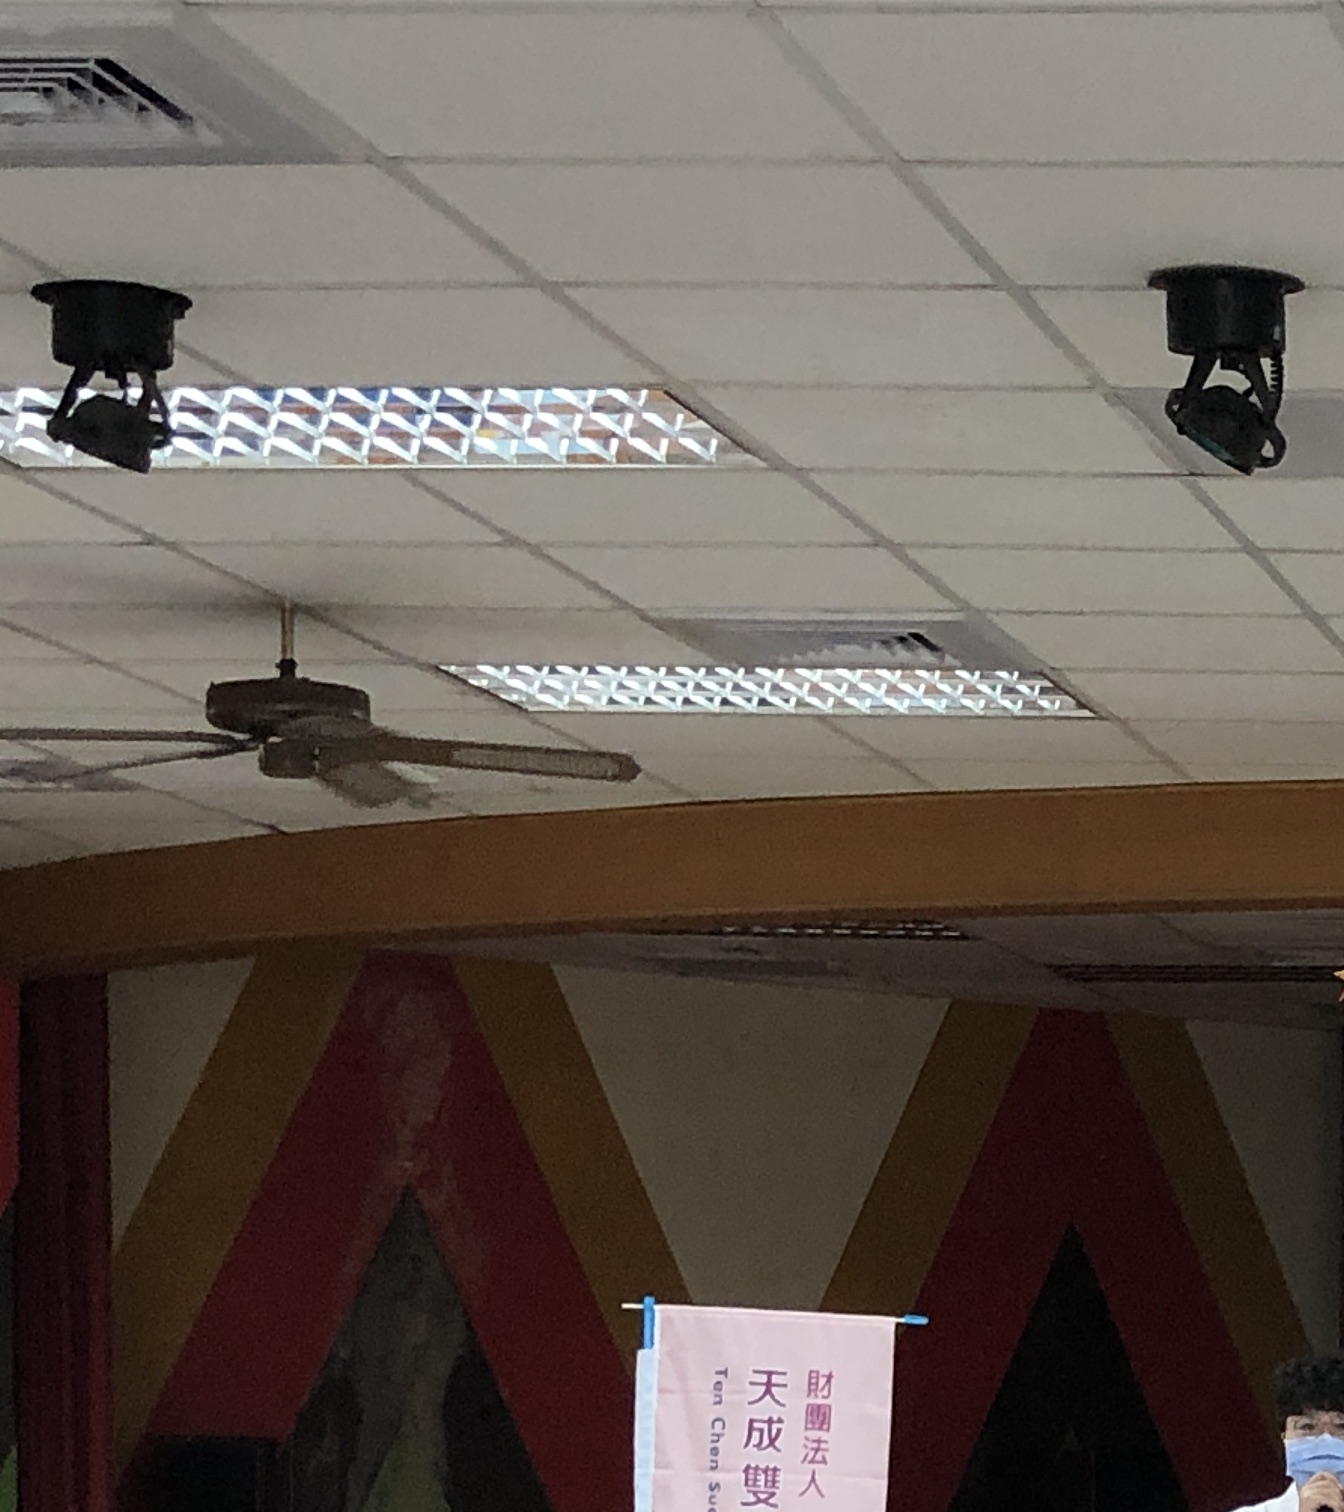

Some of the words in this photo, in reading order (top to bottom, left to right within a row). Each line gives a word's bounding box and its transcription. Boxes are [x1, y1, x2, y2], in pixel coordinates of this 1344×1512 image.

[711, 1367, 729, 1406] Ten
[709, 1416, 726, 1472] Chen
[799, 1369, 835, 1499] 財團法人
